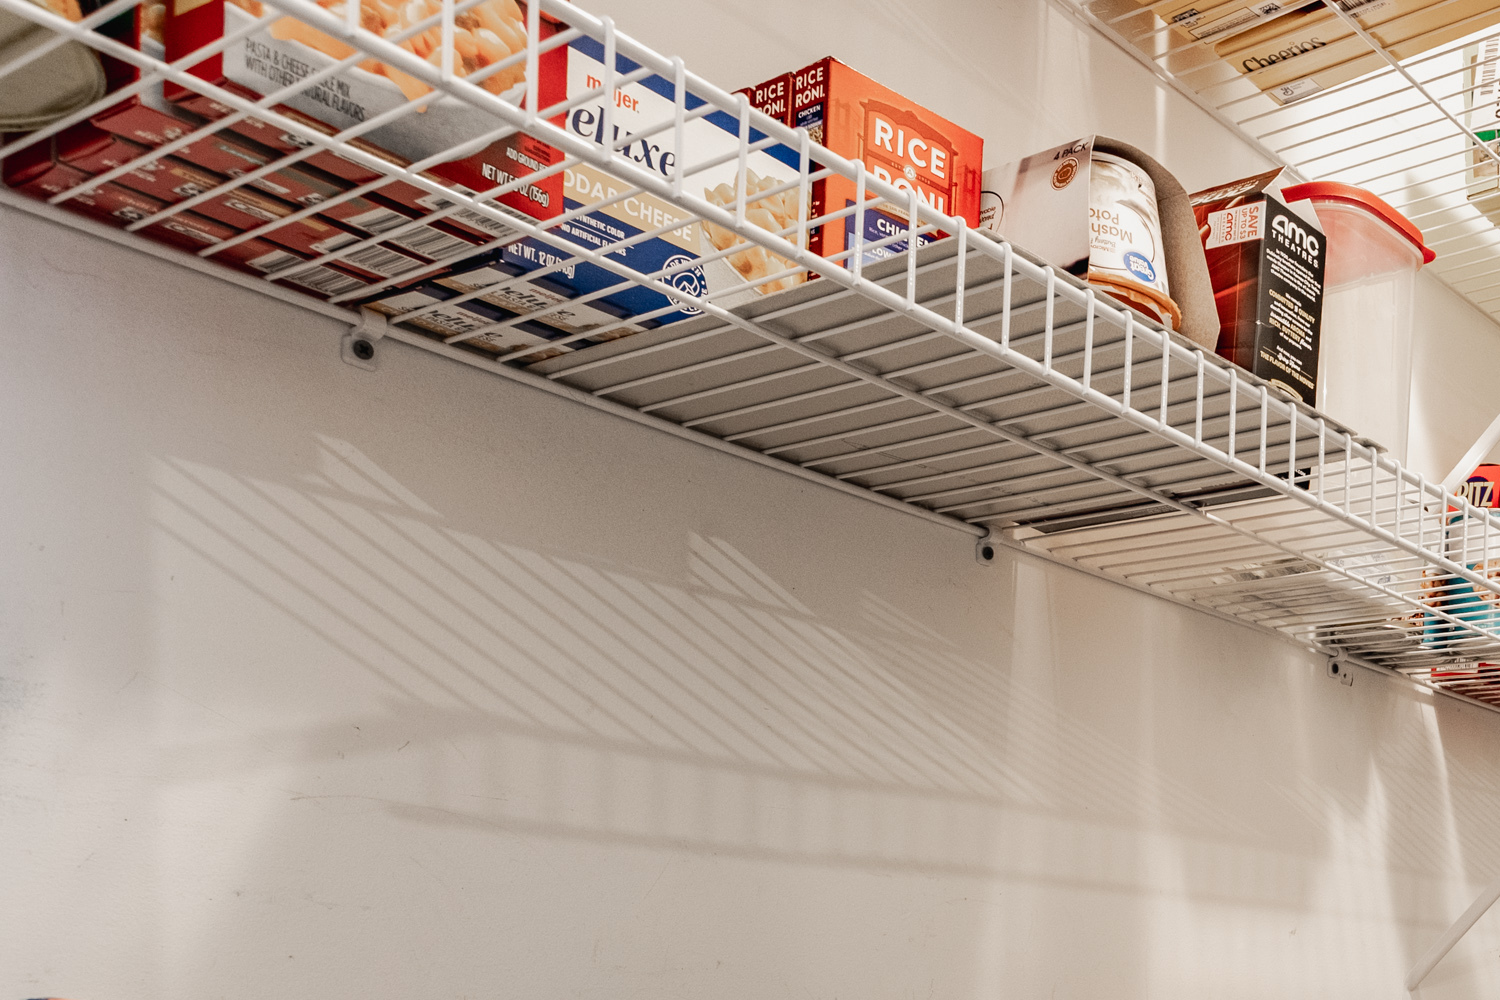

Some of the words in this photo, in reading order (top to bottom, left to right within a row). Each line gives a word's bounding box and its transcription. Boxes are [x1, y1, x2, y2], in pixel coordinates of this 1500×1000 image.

[1242, 36, 1327, 73] Cheerios
[756, 82, 785, 104] RICE
[795, 67, 824, 91] RICE
[566, 104, 676, 177] eluxe
[874, 117, 946, 180] RICE
[1062, 142, 1089, 159] PACK
[482, 163, 495, 179] NET
[1247, 206, 1259, 238] SAVE
[508, 244, 523, 259] NET
[1271, 229, 1319, 268] THEATRES
